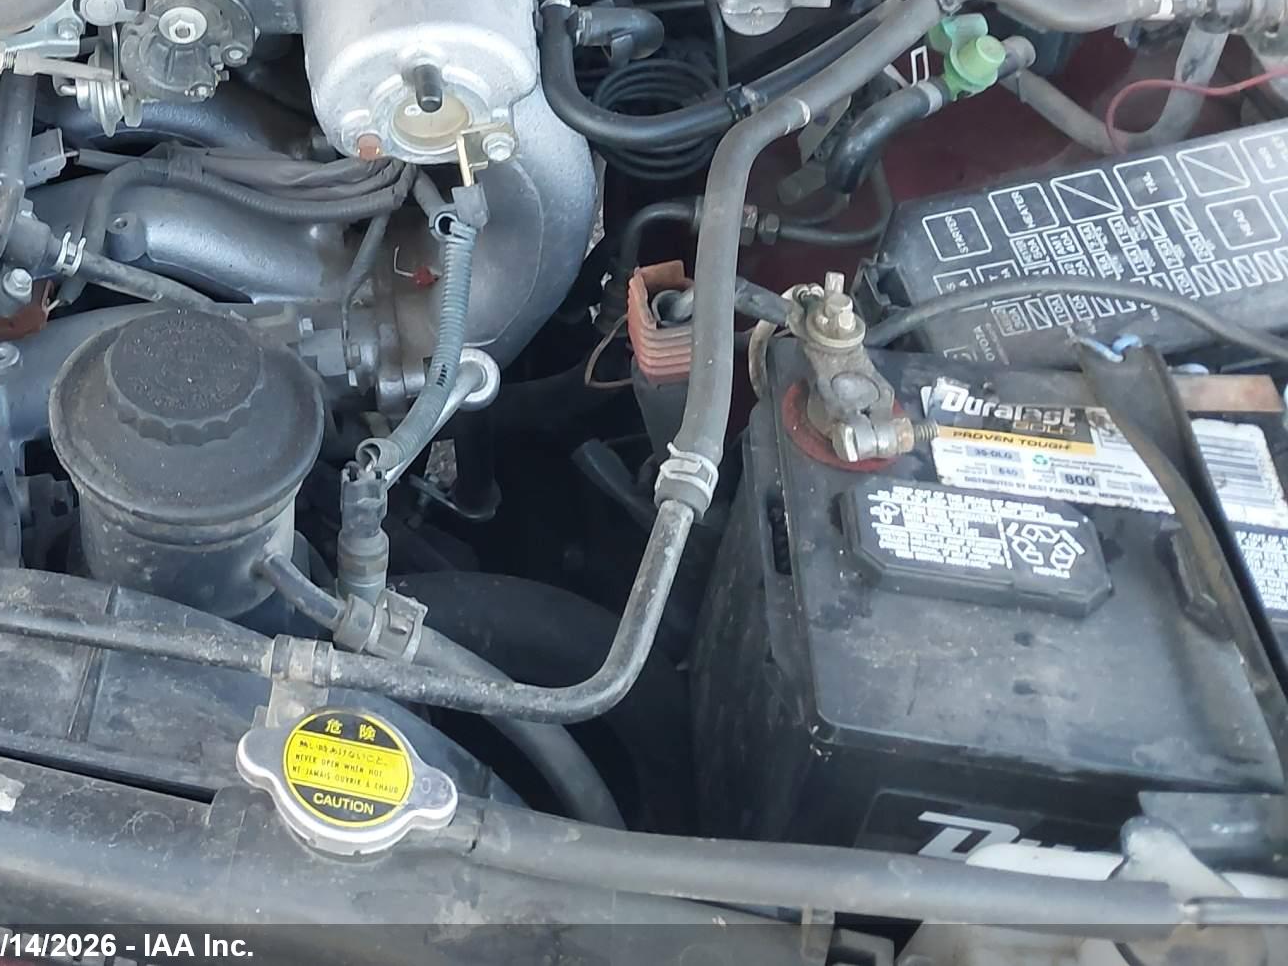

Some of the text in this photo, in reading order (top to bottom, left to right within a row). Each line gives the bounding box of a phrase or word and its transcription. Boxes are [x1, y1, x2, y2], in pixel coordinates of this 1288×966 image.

[1011, 191, 1036, 229] HEATER
[944, 215, 968, 254] STARTER
[1051, 303, 1064, 320] 10A
[1073, 295, 1087, 315] 10A
[973, 325, 995, 361] OYOTA
[941, 390, 1076, 427] Duralast
[953, 431, 1014, 444] PROVEN
[1065, 473, 1096, 487] 800
[296, 753, 383, 778] NEVER OPEN WHEN HOT
[292, 765, 300, 773] NE
[306, 768, 330, 780] JAMAIS
[334, 773, 361, 786] OUVRIR
[374, 783, 399, 794] CHAUD
[313, 792, 374, 816] CAUTION
